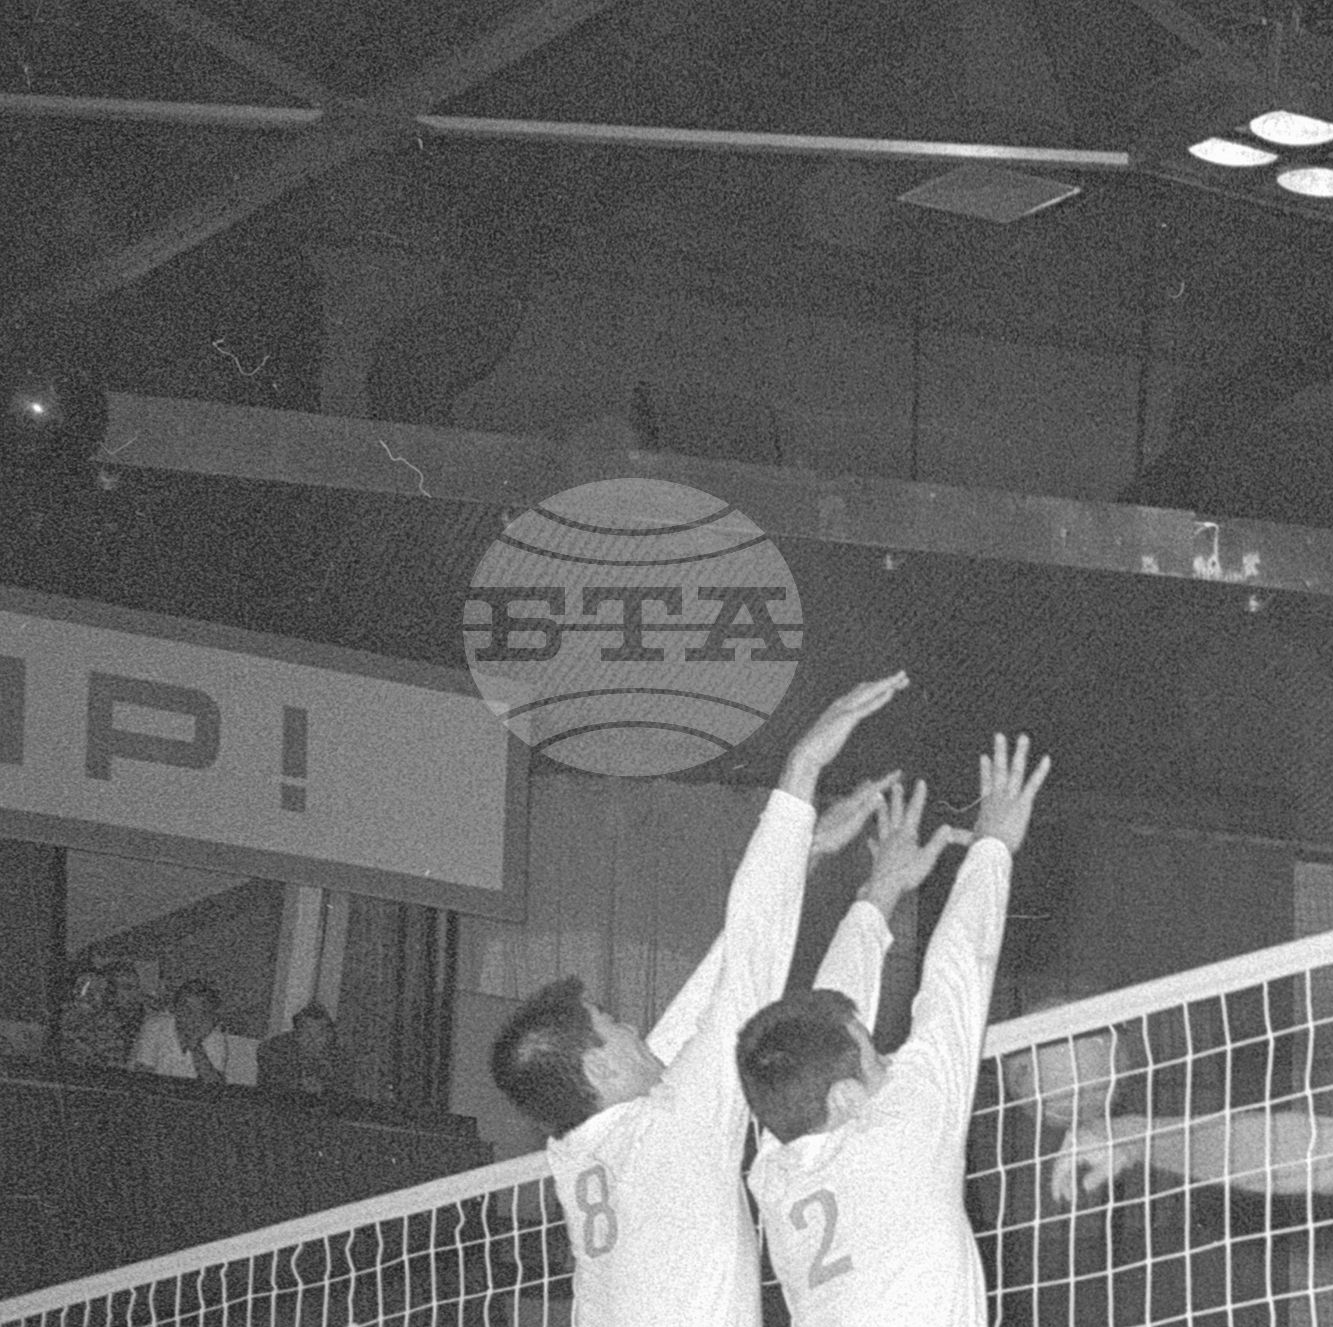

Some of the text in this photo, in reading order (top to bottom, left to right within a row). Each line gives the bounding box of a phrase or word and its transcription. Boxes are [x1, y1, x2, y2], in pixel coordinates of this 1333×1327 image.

[0, 655, 309, 813] Р!
[574, 1163, 618, 1259] 8
[789, 1187, 855, 1290] 2
